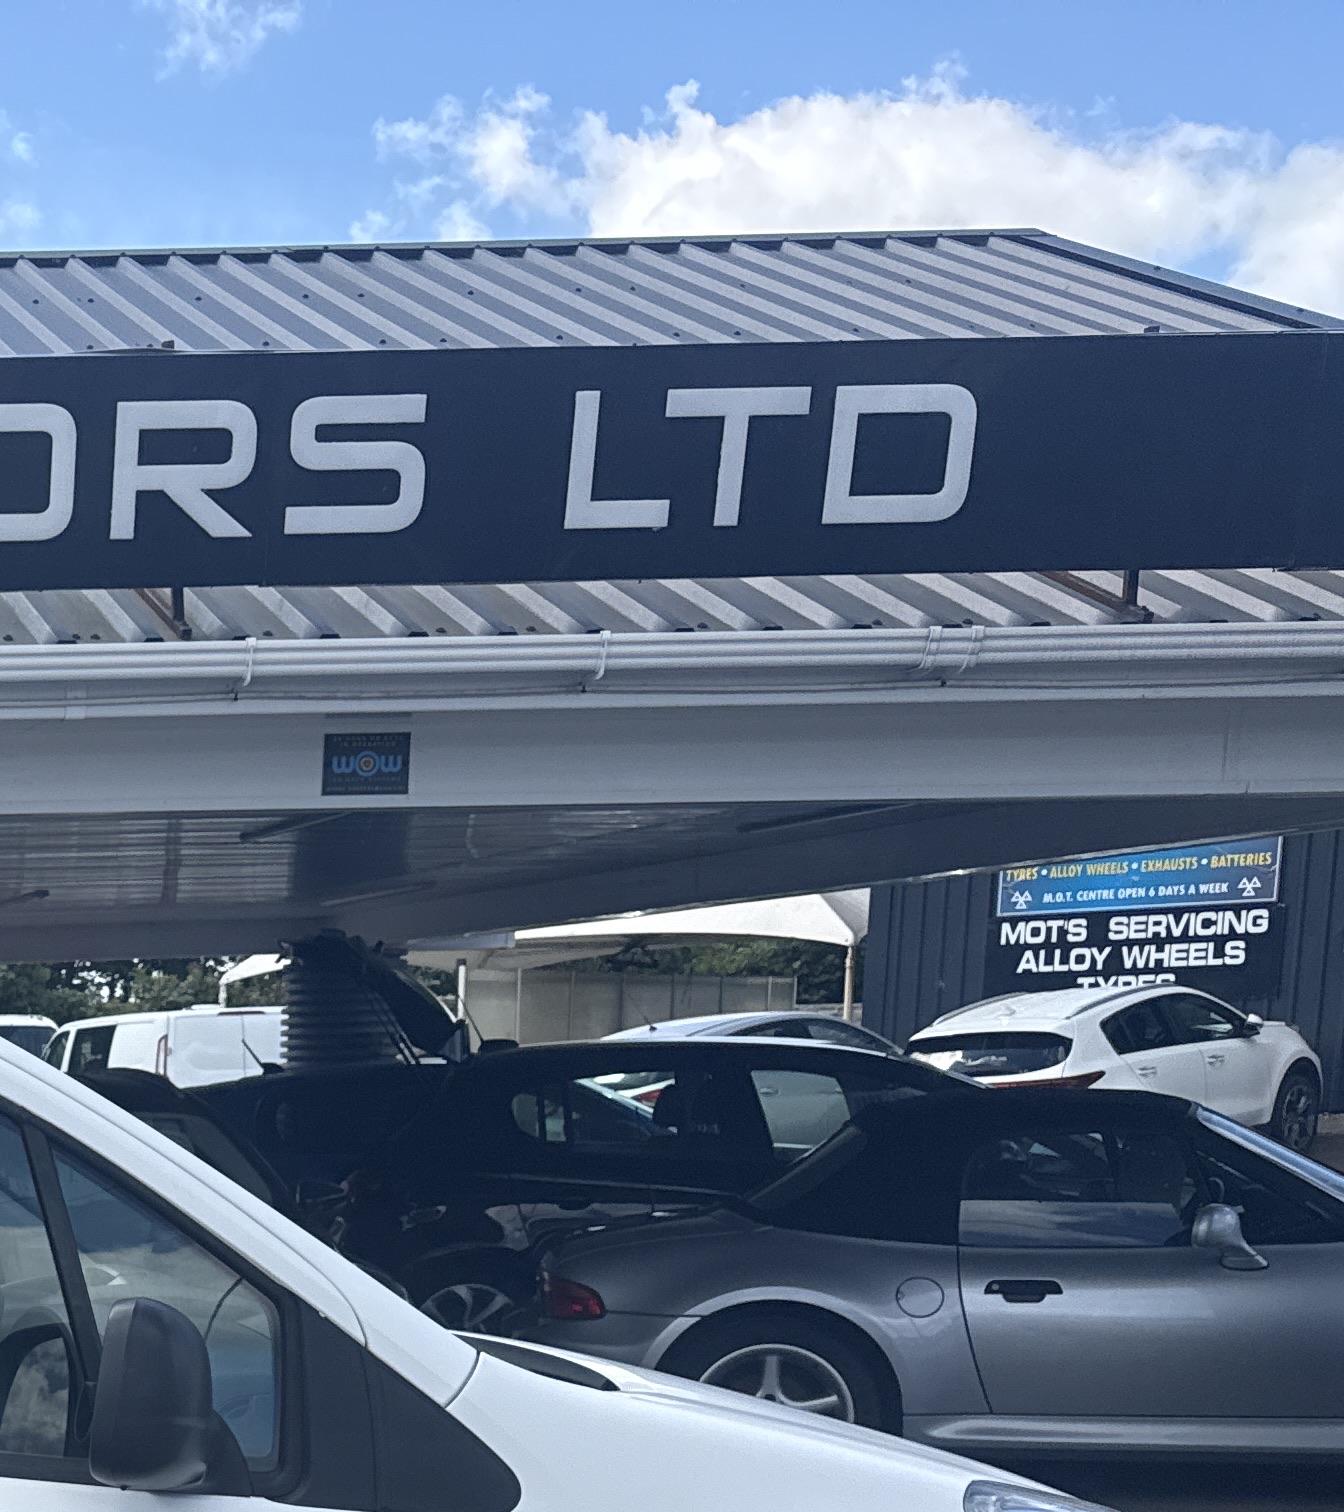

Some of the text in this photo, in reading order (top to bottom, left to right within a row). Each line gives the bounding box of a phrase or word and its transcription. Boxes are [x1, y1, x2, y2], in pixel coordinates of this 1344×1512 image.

[564, 385, 978, 529] LTD
[1006, 852, 1272, 881] TYRES ALLOY WHEELS EXHAUSTS BATTERIES
[1076, 888, 1115, 901] CENTRE
[1118, 886, 1145, 899] OPEN
[1148, 886, 1155, 897] 6
[1157, 884, 1185, 896] DAYS
[1188, 884, 1196, 895] A
[1199, 882, 1229, 894] WEEK
[1000, 909, 1269, 945] MOT'S SERVICING
[1016, 940, 1246, 973] ALLOY WHEELS
